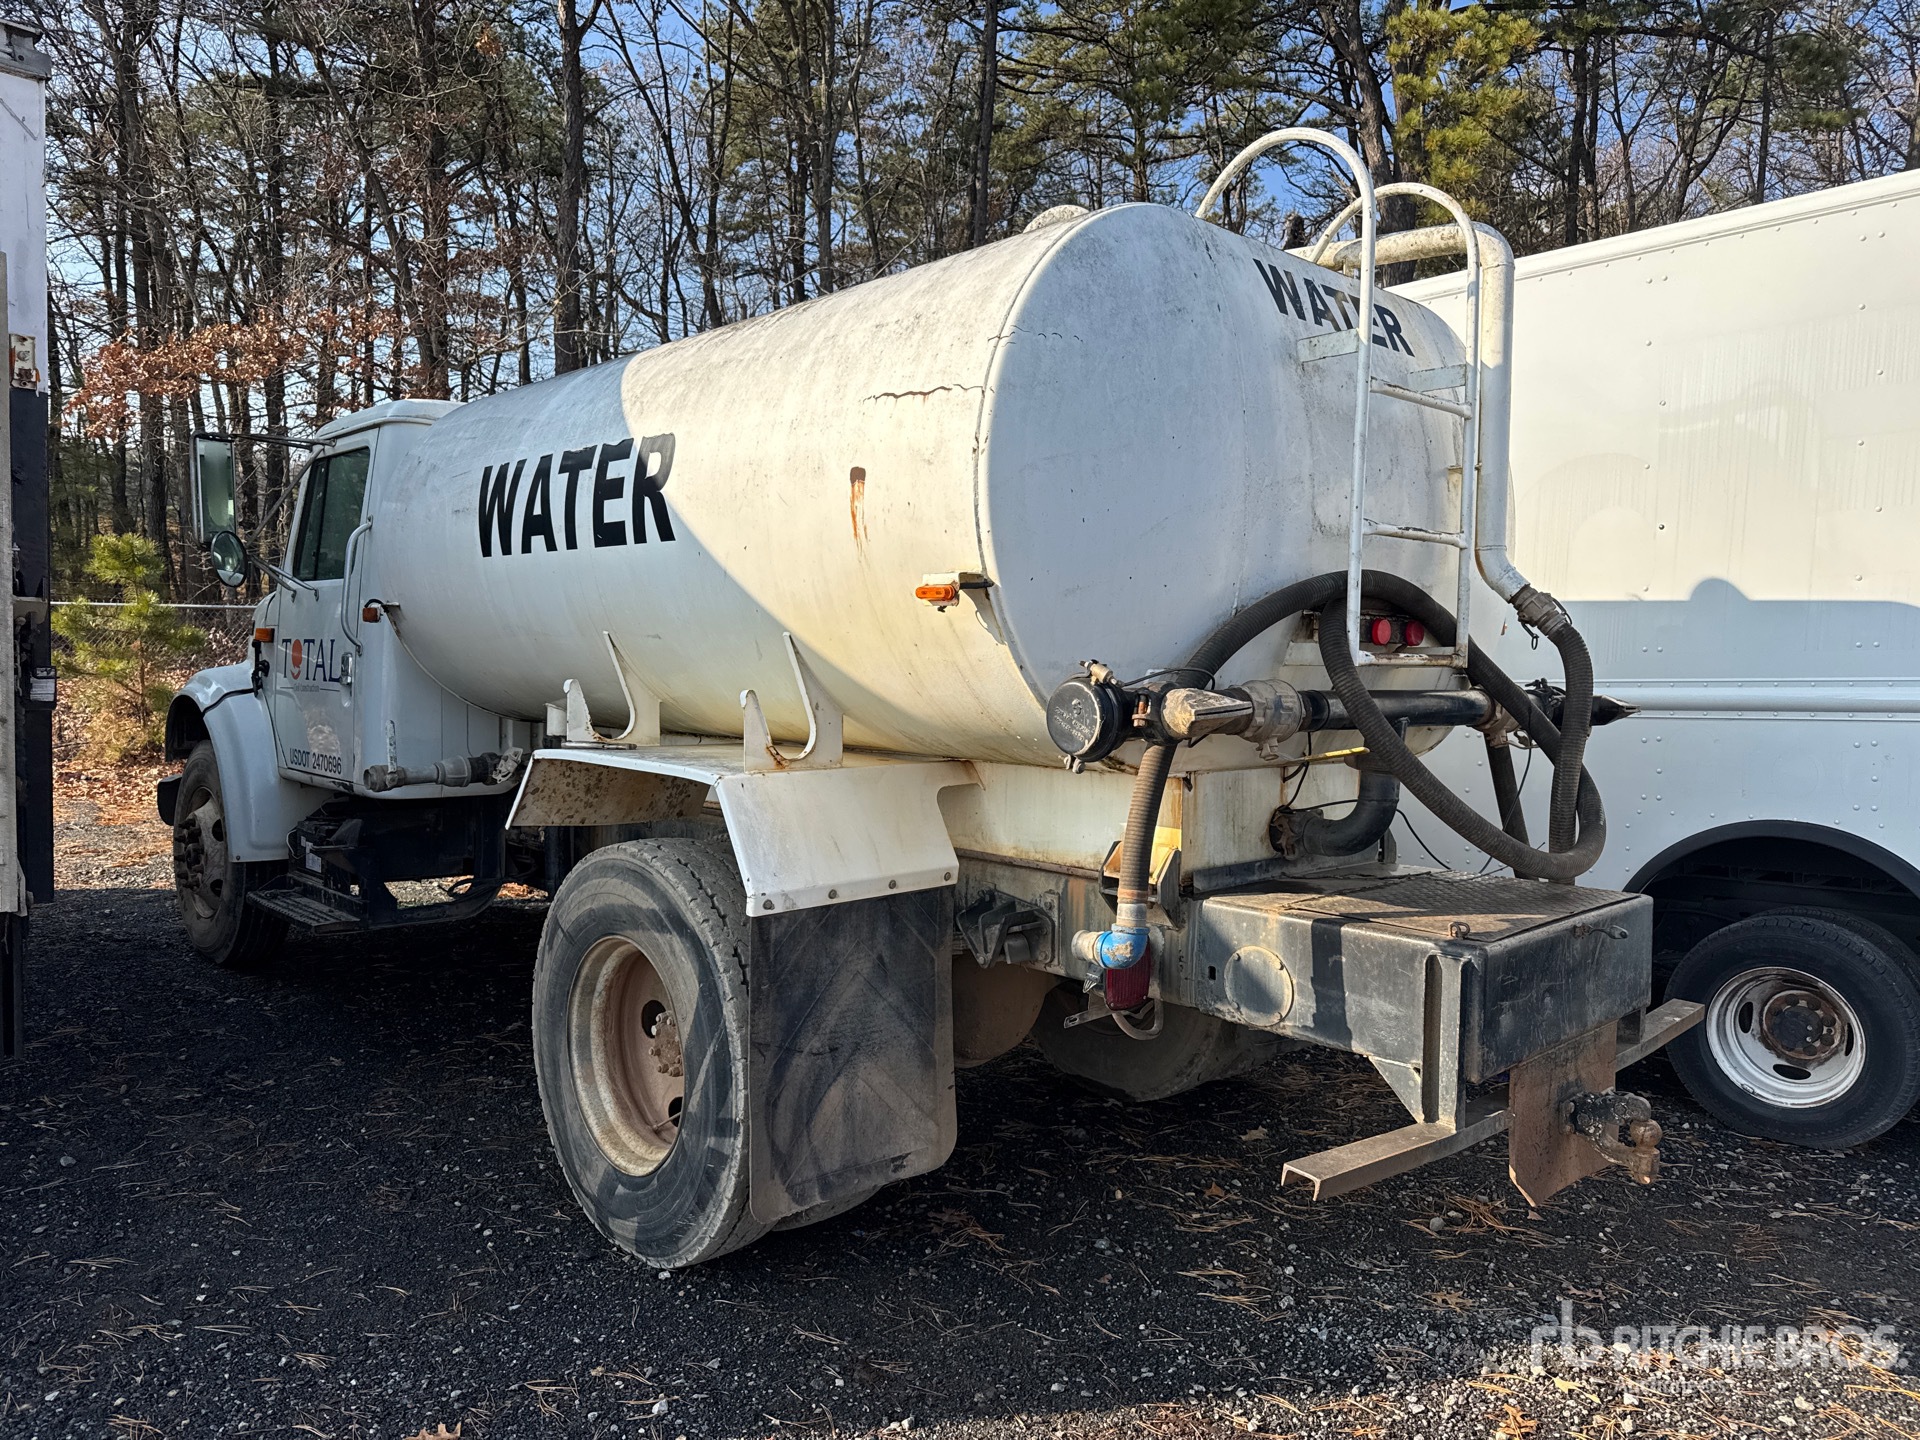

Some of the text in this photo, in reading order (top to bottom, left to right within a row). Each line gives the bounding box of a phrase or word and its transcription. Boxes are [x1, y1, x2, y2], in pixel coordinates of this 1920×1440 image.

[478, 432, 677, 558] WATER
[281, 638, 342, 683] TOTAL
[289, 748, 342, 775] USDOT 2470696
